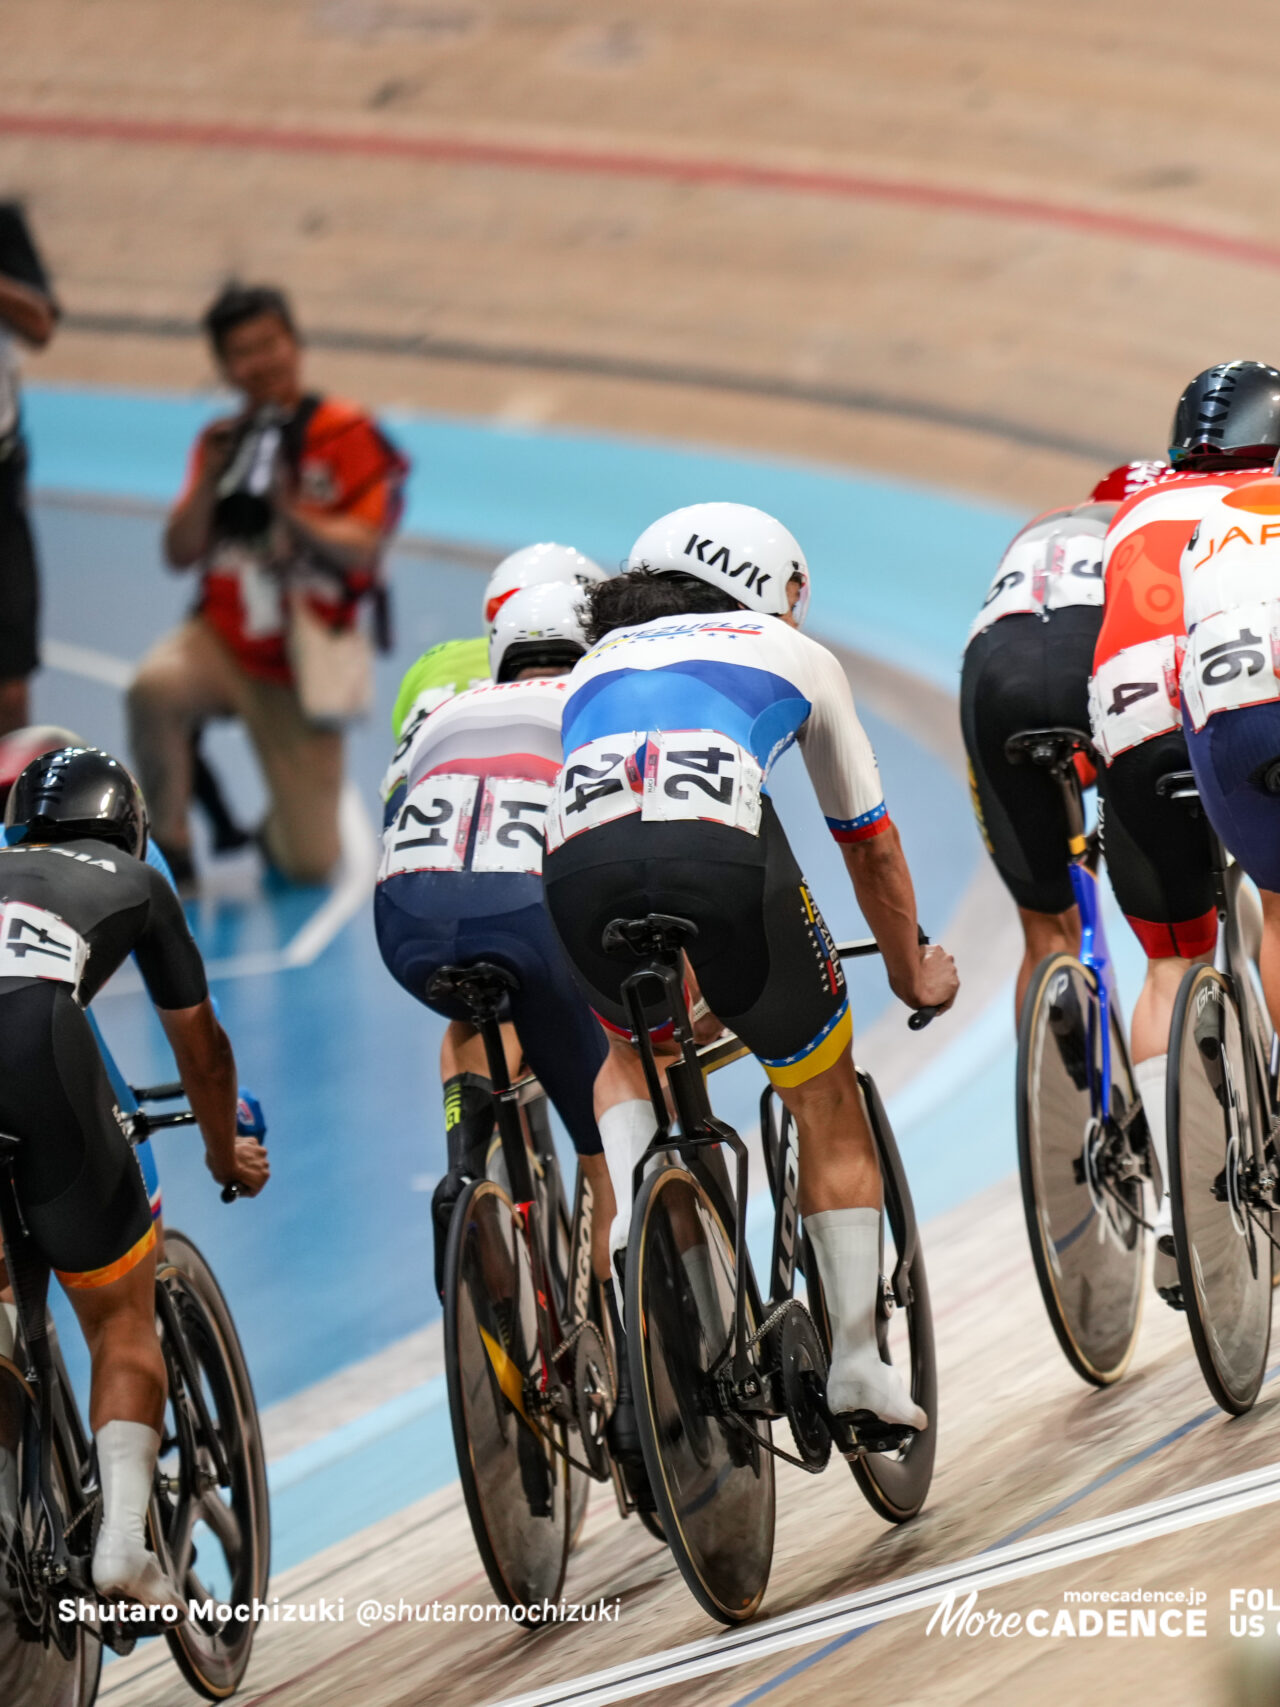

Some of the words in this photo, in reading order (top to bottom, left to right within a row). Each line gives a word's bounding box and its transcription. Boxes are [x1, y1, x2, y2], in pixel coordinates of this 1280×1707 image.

[1132, 467, 1275, 497] AUSTRI
[683, 533, 772, 597] KASK
[594, 621, 765, 652] NEZUELA
[1199, 628, 1266, 687] 16
[1106, 681, 1159, 717] 4
[565, 753, 625, 815] 24
[664, 746, 735, 807] 24
[394, 798, 455, 851] 21
[496, 799, 549, 849] 21
[5, 917, 72, 963] 17
